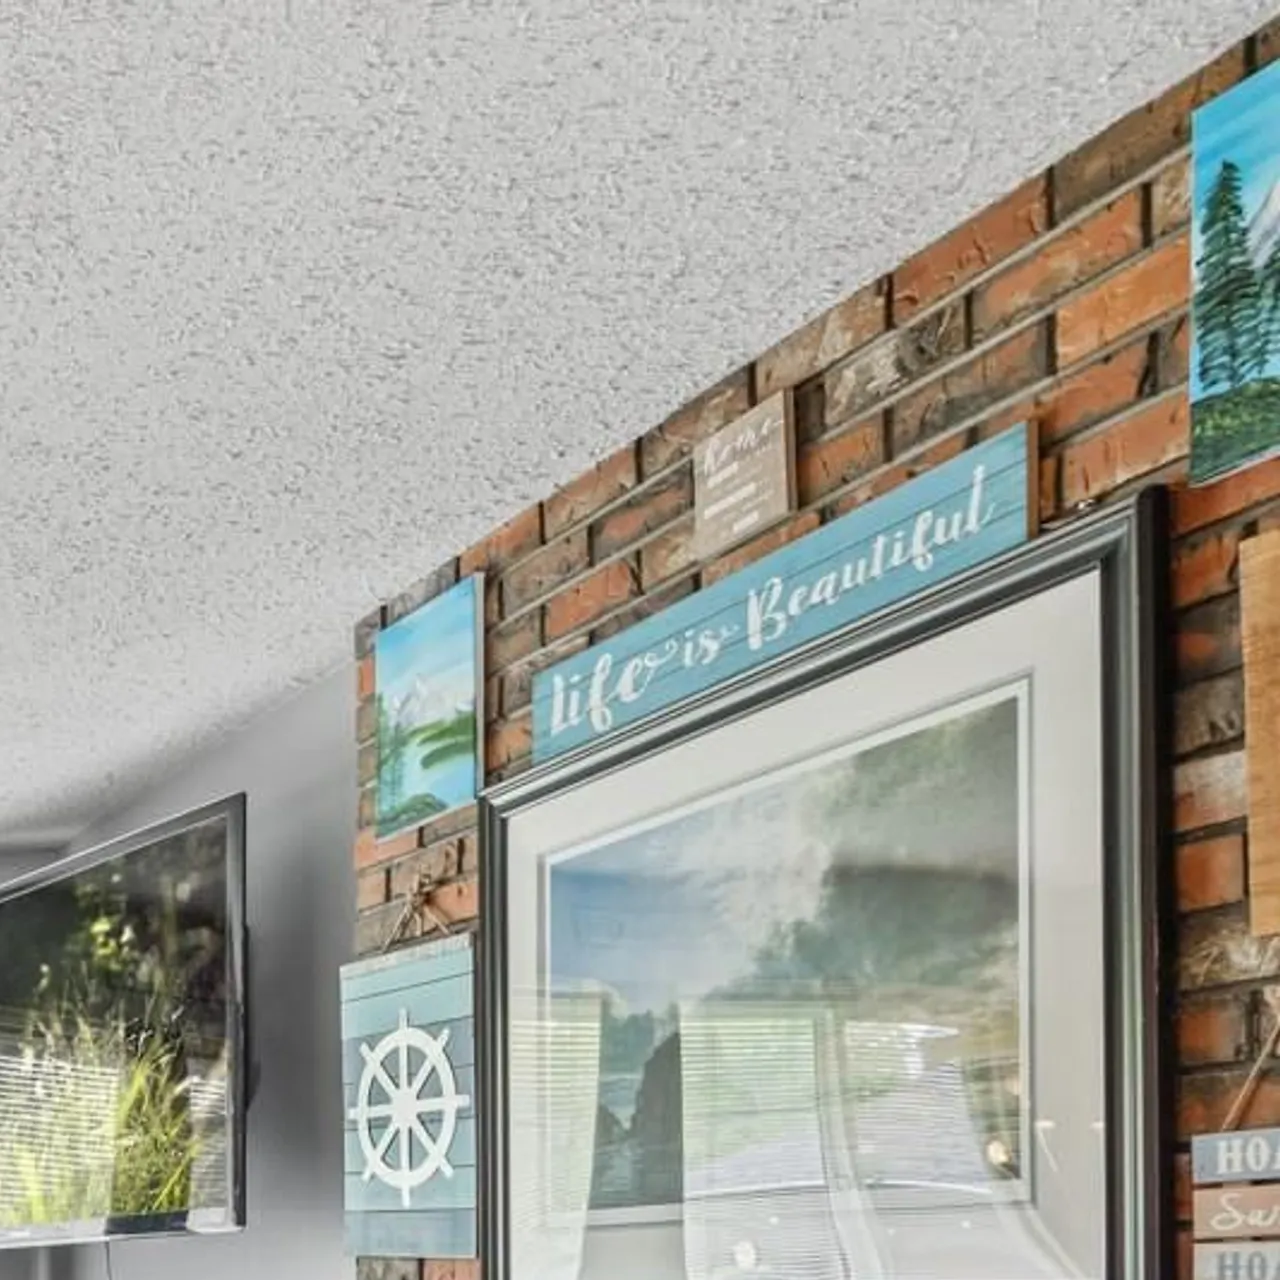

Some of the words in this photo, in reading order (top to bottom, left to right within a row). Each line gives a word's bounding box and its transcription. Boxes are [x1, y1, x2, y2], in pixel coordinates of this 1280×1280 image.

[684, 624, 740, 668] is
[747, 464, 998, 650] Beautiful
[1216, 1134, 1280, 1175] HO
